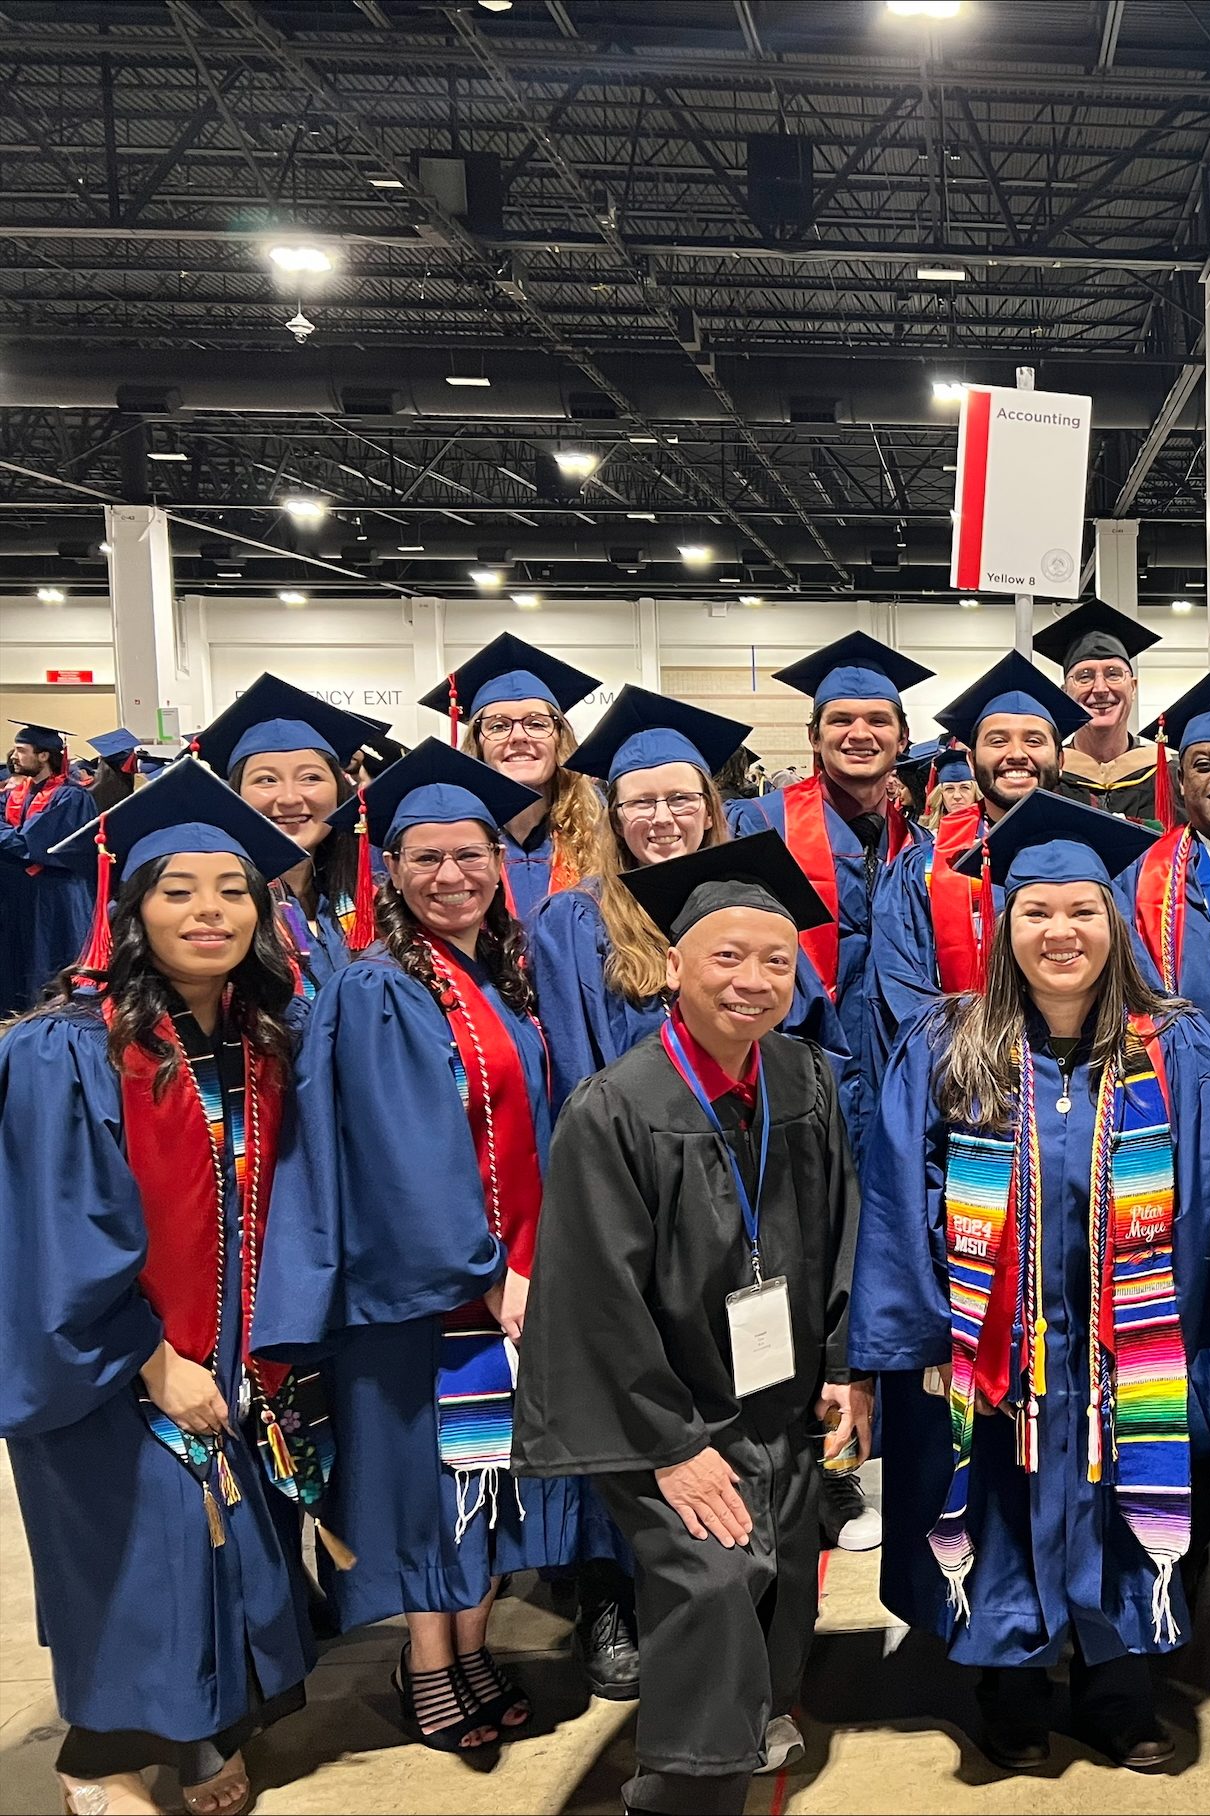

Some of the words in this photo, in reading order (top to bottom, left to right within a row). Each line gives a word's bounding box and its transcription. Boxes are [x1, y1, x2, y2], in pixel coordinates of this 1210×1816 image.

[996, 407, 1081, 429] Accounting
[987, 572, 1025, 584] Yellow
[1028, 576, 1036, 586] 8
[363, 690, 403, 705] EXIT
[1130, 1203, 1164, 1221] Pilar
[952, 1214, 992, 1238] 2024
[954, 1234, 988, 1257] MSU
